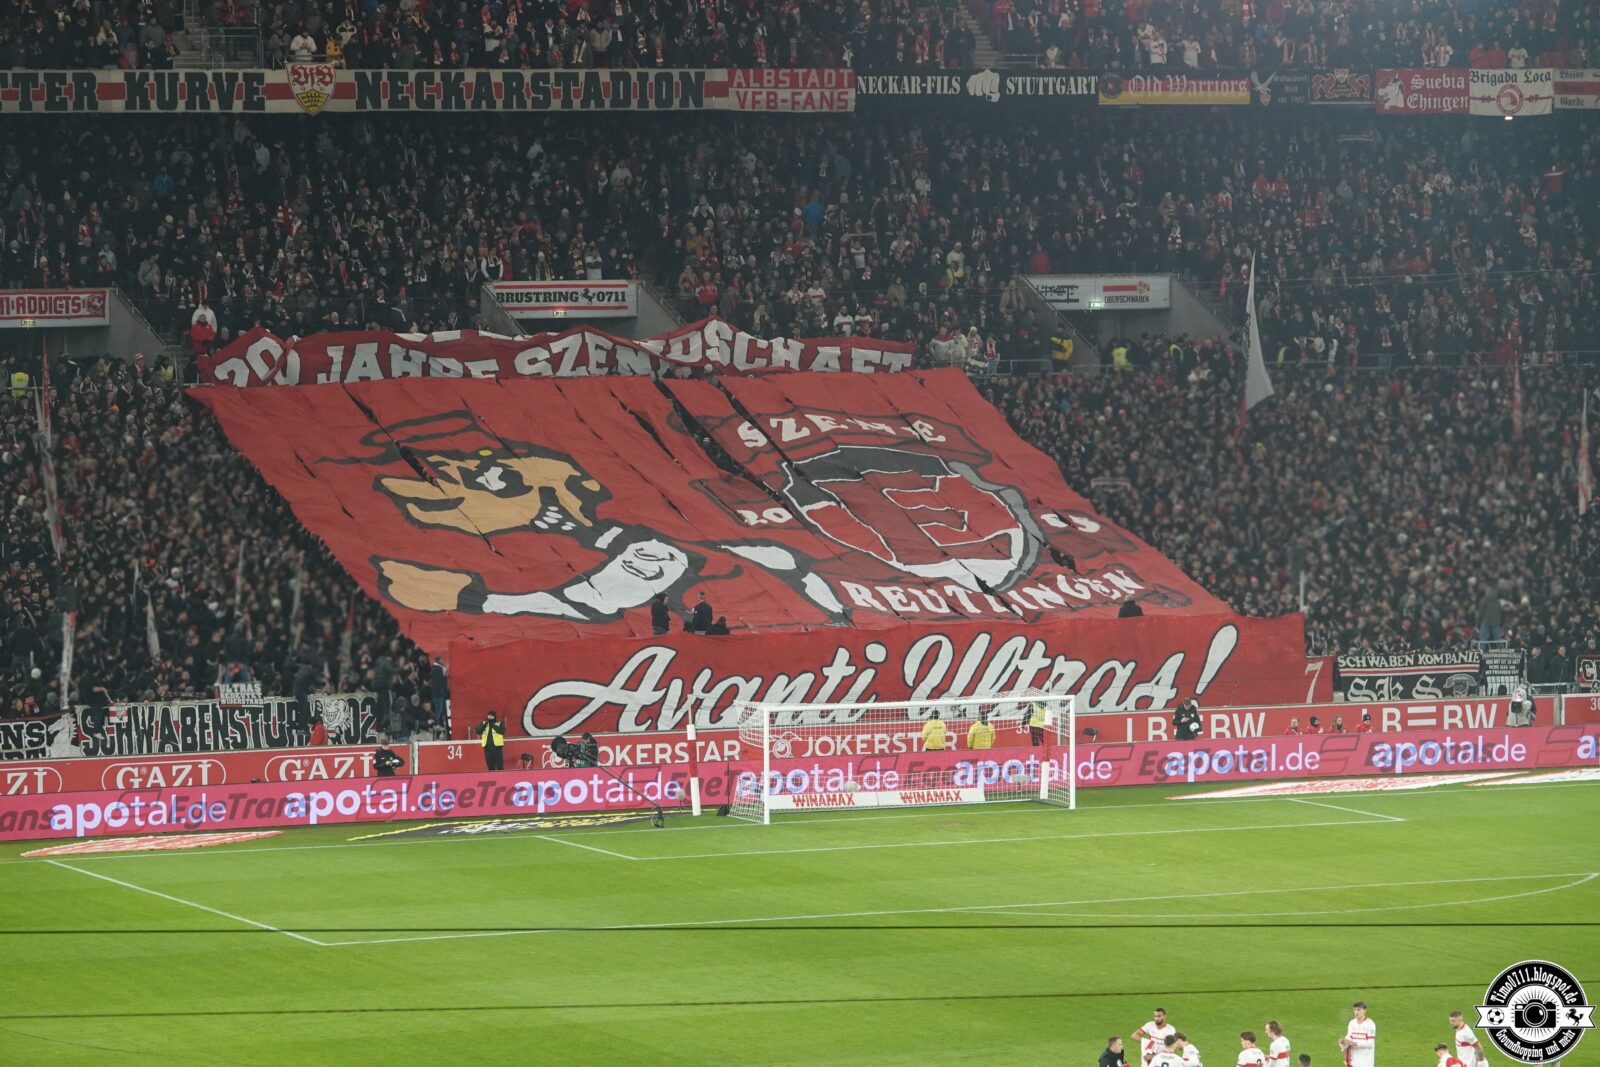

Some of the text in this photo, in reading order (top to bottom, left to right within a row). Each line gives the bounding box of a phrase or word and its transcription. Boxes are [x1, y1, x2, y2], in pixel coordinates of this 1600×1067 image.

[354, 70, 705, 110] NECKARSTADION
[733, 69, 852, 88] ALBSTADT
[857, 75, 960, 95] NECKAR-FILS
[1006, 75, 1098, 95] STUTTGART
[1128, 74, 1162, 98] Old
[1166, 74, 1249, 98] Warriors
[1410, 74, 1465, 90] Suebia
[1469, 70, 1552, 86] Brigada Loca
[125, 71, 265, 111] KURVE
[735, 90, 850, 110] VFB-FANS
[15, 295, 81, 315] ADDICTS
[496, 290, 626, 304] BRUSTRING 0711
[1104, 295, 1150, 304] OBERSCHWABEN
[737, 414, 947, 448] SZENE
[840, 569, 1146, 617] REUTLINGEN
[1337, 651, 1415, 668] SCHWABEN
[1417, 649, 1482, 666] KOMPANIE
[219, 682, 262, 693] ULTRAS
[522, 643, 888, 738] Avanti
[447, 745, 463, 760] 34
[598, 739, 741, 767] OKERSTAR
[802, 731, 957, 758] JOKERSTR
[1371, 734, 1527, 773] apotal.de
[954, 752, 1113, 788] apotalde
[1164, 742, 1321, 782] apotal.de
[7, 766, 48, 795] ZI
[513, 771, 681, 813] apotal.de
[284, 781, 456, 824] apotal.de
[792, 793, 856, 807] WINAMAX
[899, 789, 963, 804] WINAMAX
[51, 793, 227, 837] apotal.de
